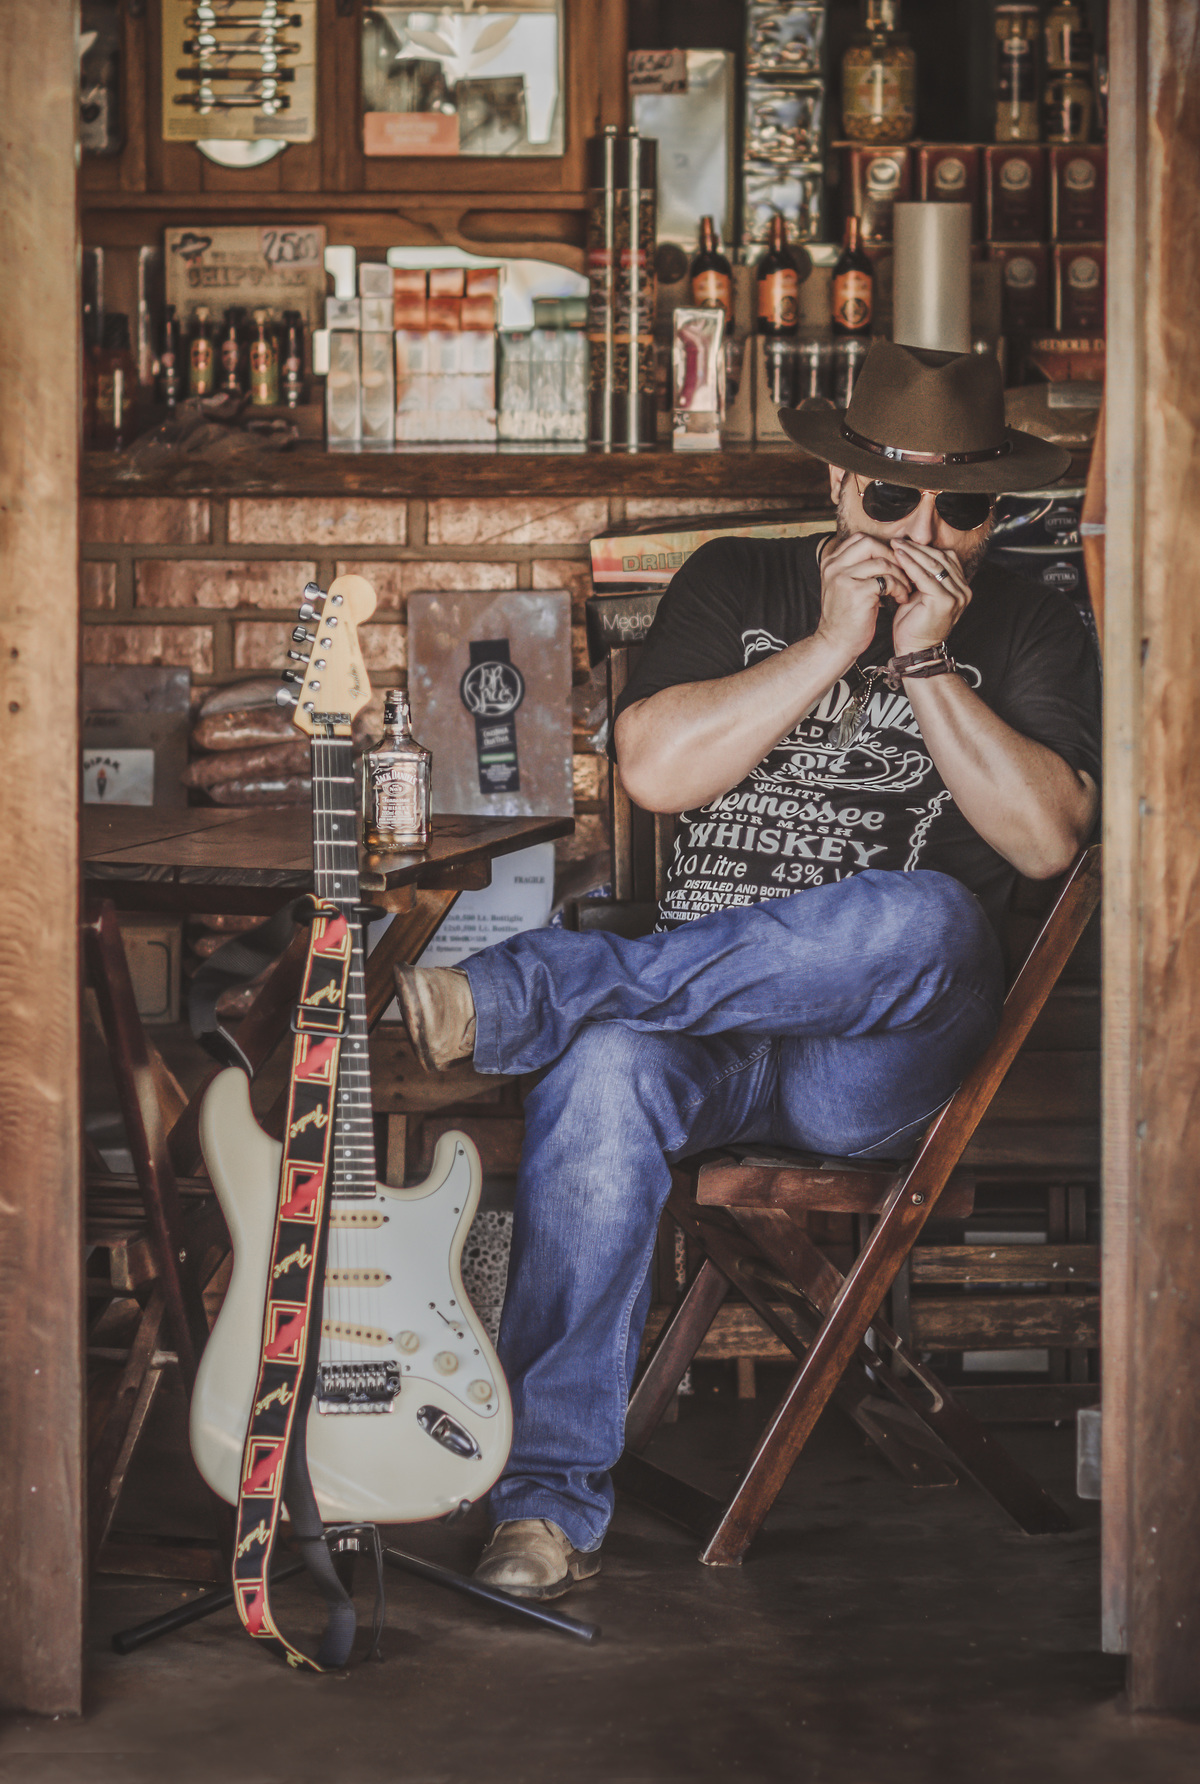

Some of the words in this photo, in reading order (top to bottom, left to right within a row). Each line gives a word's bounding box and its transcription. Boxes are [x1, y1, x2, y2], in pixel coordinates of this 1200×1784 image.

[753, 782, 826, 801] QUALITY
[776, 819, 854, 837] MASH
[688, 822, 889, 868] WHISKEY
[700, 854, 748, 879] Litre
[771, 862, 825, 886] 43%
[684, 879, 734, 893] DISTILLED
[735, 884, 758, 896] AND
[671, 900, 691, 910] LEM
[688, 890, 755, 907] DANIEL
